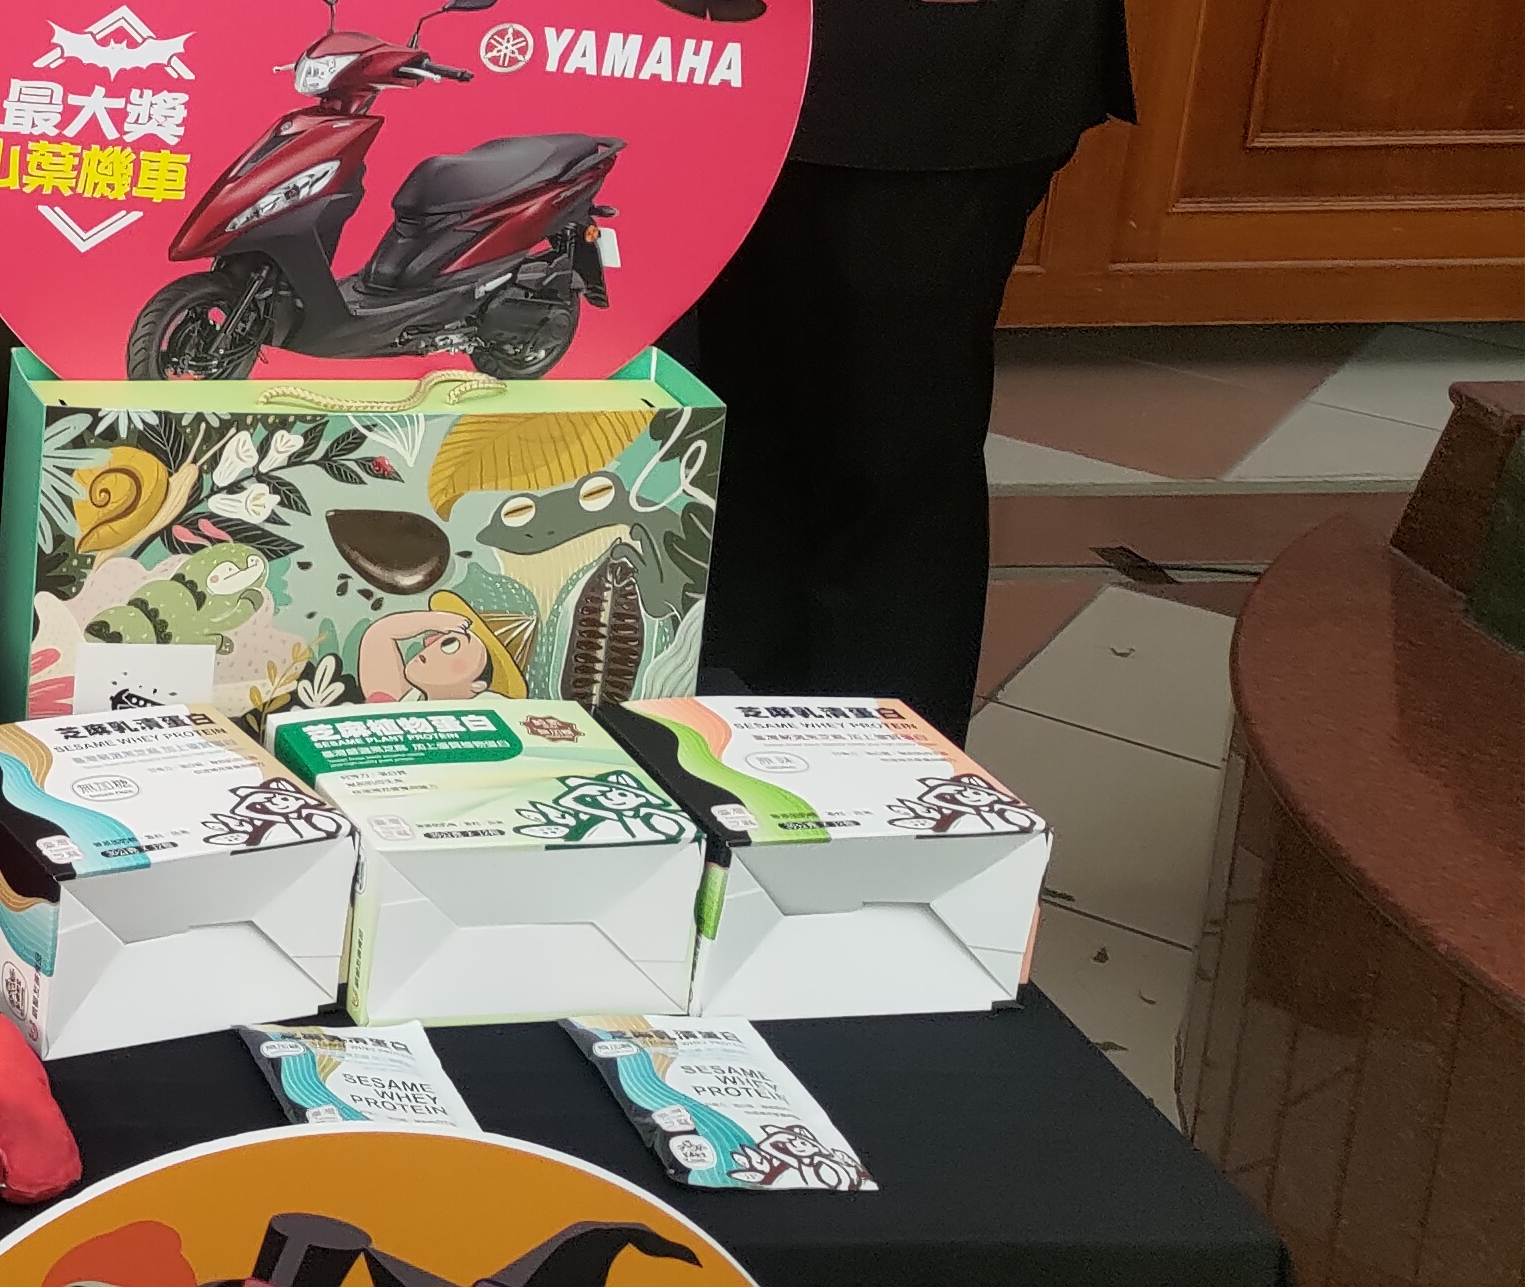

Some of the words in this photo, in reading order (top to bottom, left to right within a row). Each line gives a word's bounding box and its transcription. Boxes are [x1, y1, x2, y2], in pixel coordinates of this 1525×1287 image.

[544, 27, 743, 89] YAMAHA
[2, 78, 190, 146] 最大獎
[53, 739, 117, 753] SESAME
[118, 733, 160, 746] WHEY
[342, 1073, 436, 1094] SESAME
[350, 1094, 449, 1117] PROTEIN
[374, 1089, 438, 1105] WHEY
